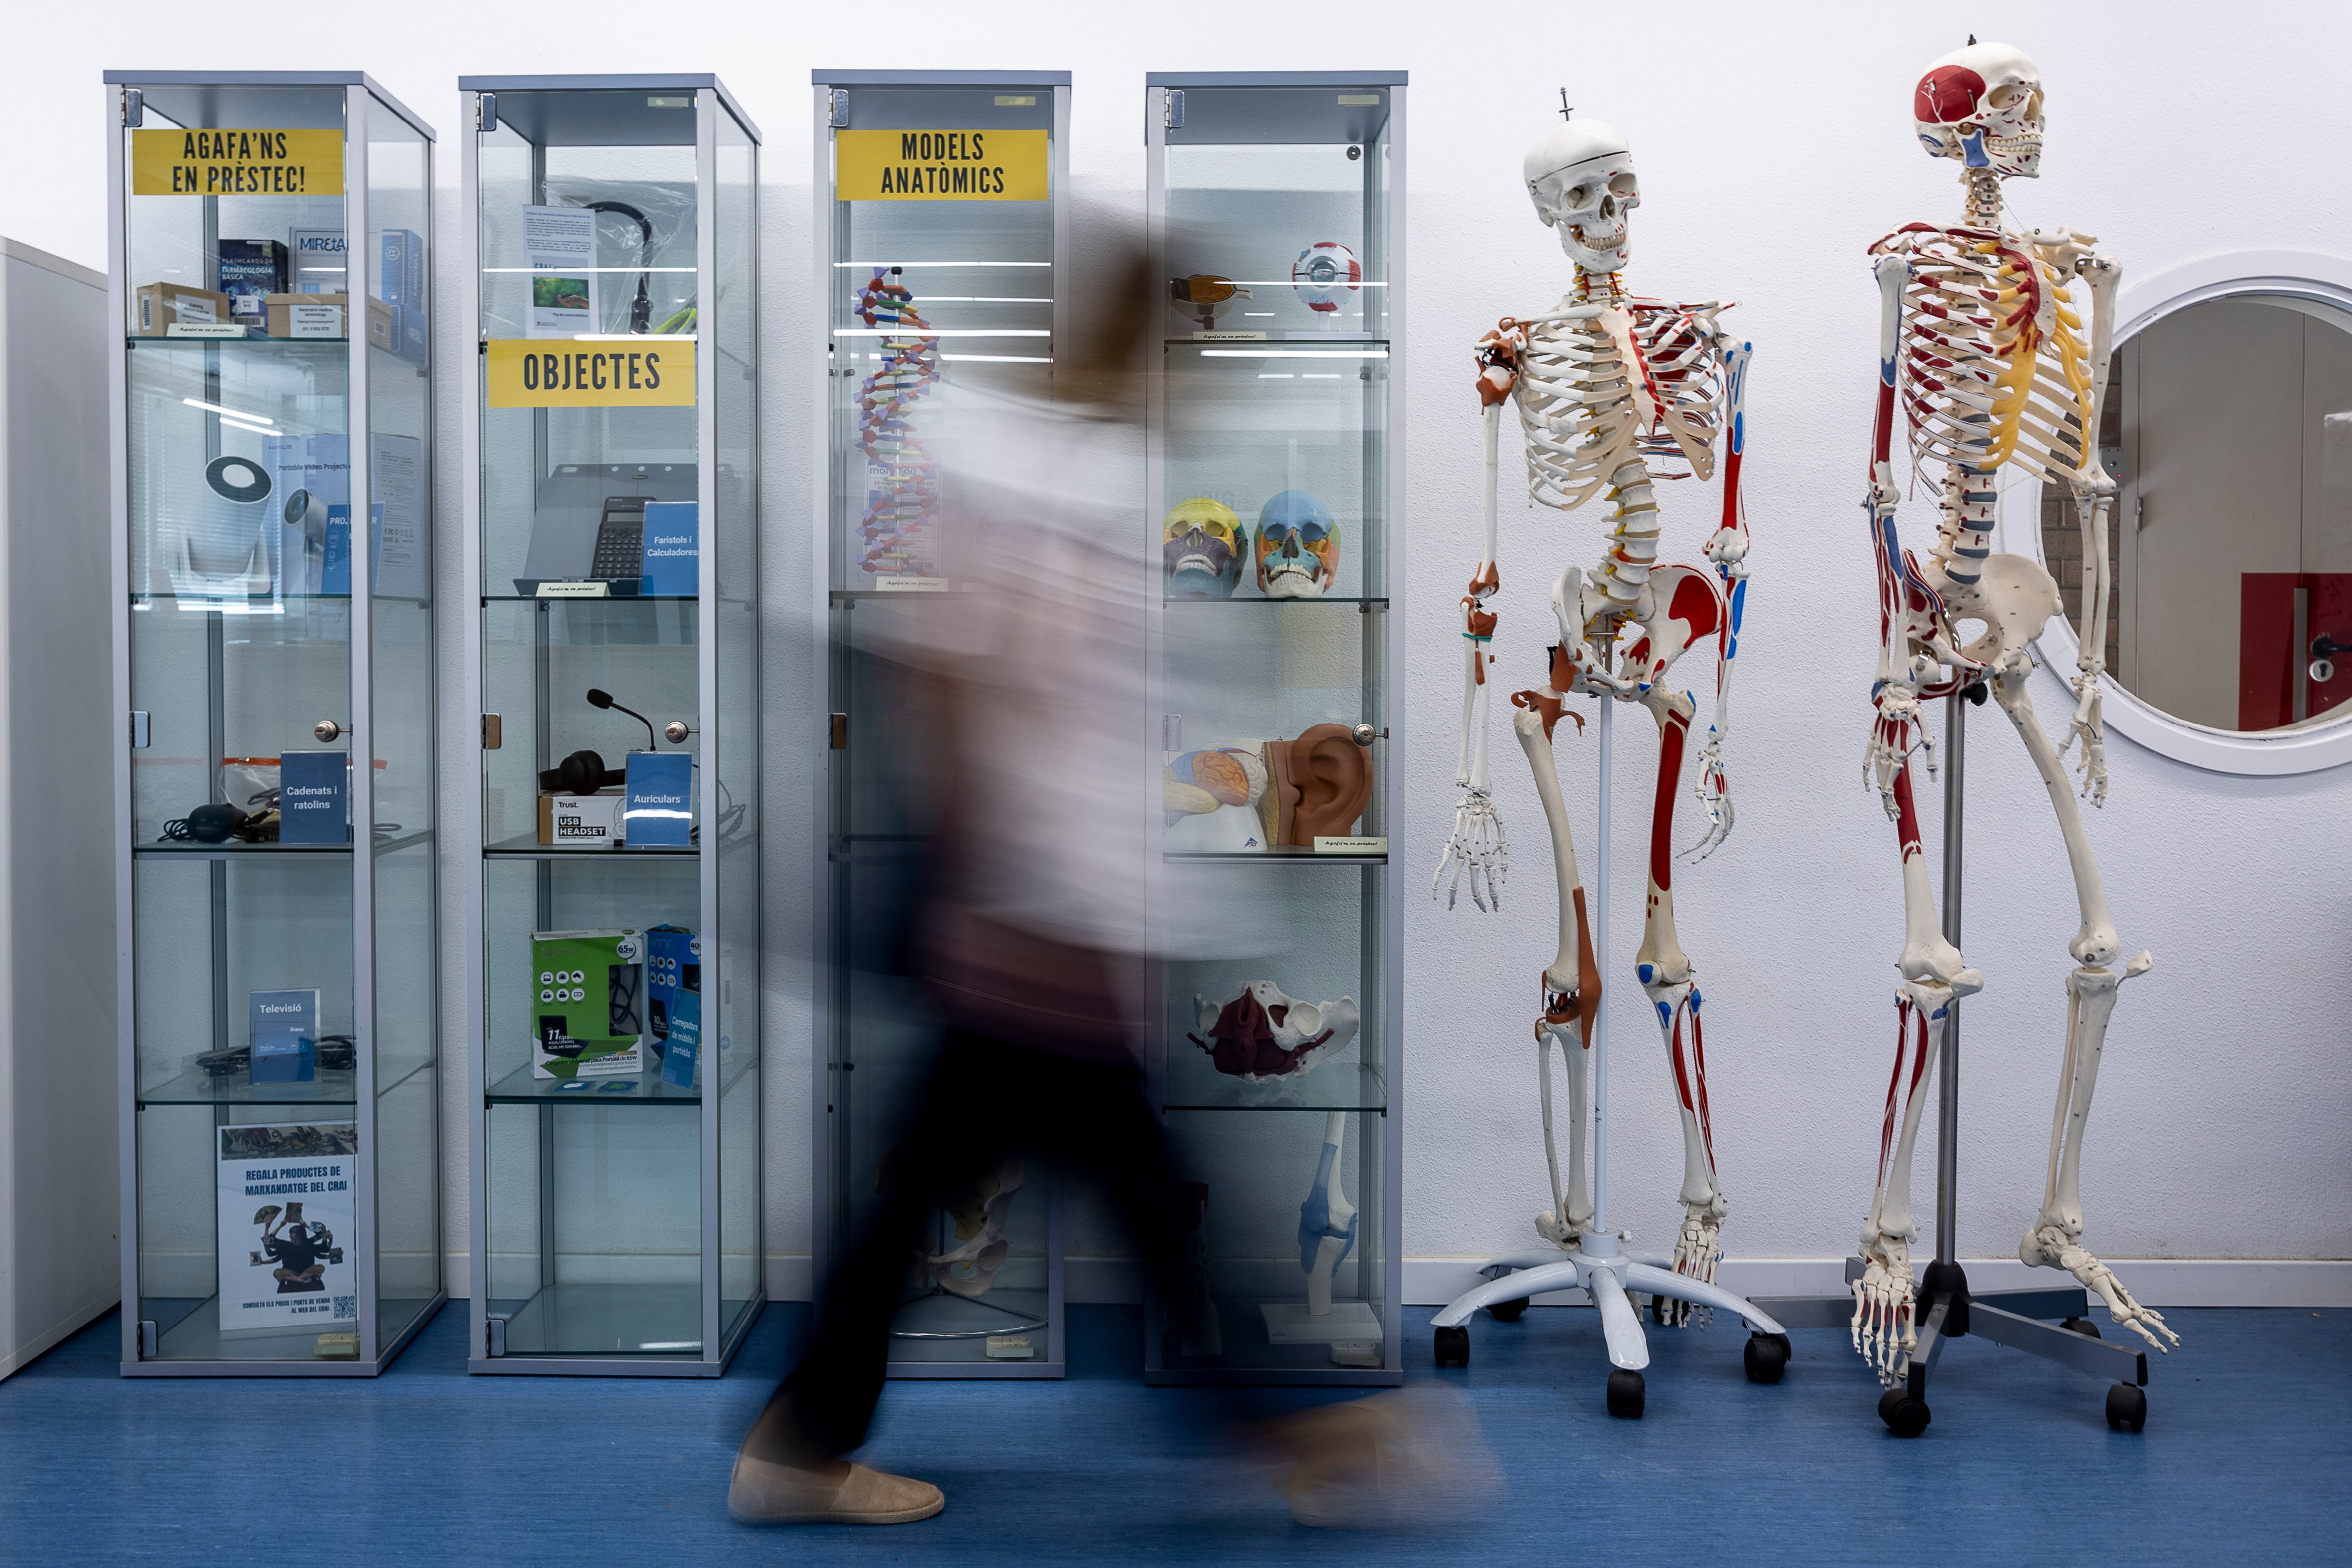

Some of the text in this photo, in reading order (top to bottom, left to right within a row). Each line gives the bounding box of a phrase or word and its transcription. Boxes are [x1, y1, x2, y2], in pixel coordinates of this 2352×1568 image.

[183, 132, 287, 159] AGAFA'NS
[902, 133, 983, 160] MODELS
[173, 161, 305, 193] EN PRÈSTEC!
[881, 162, 1004, 193] ANATÒMICS
[523, 353, 661, 390] OBJECTES
[654, 535, 692, 544] Faristols i
[647, 548, 698, 557] Calculadores
[287, 785, 338, 795] Cadenats i
[294, 800, 330, 810] ratolins
[633, 794, 681, 804] Auriculars
[259, 1003, 302, 1014] Televisió
[672, 1016, 698, 1032] Carregadors
[672, 1030, 678, 1039] de
[246, 1166, 341, 1181] REGALA PRODUCTES DE
[245, 1180, 347, 1196] MARXANDATGE DEL CRAI
